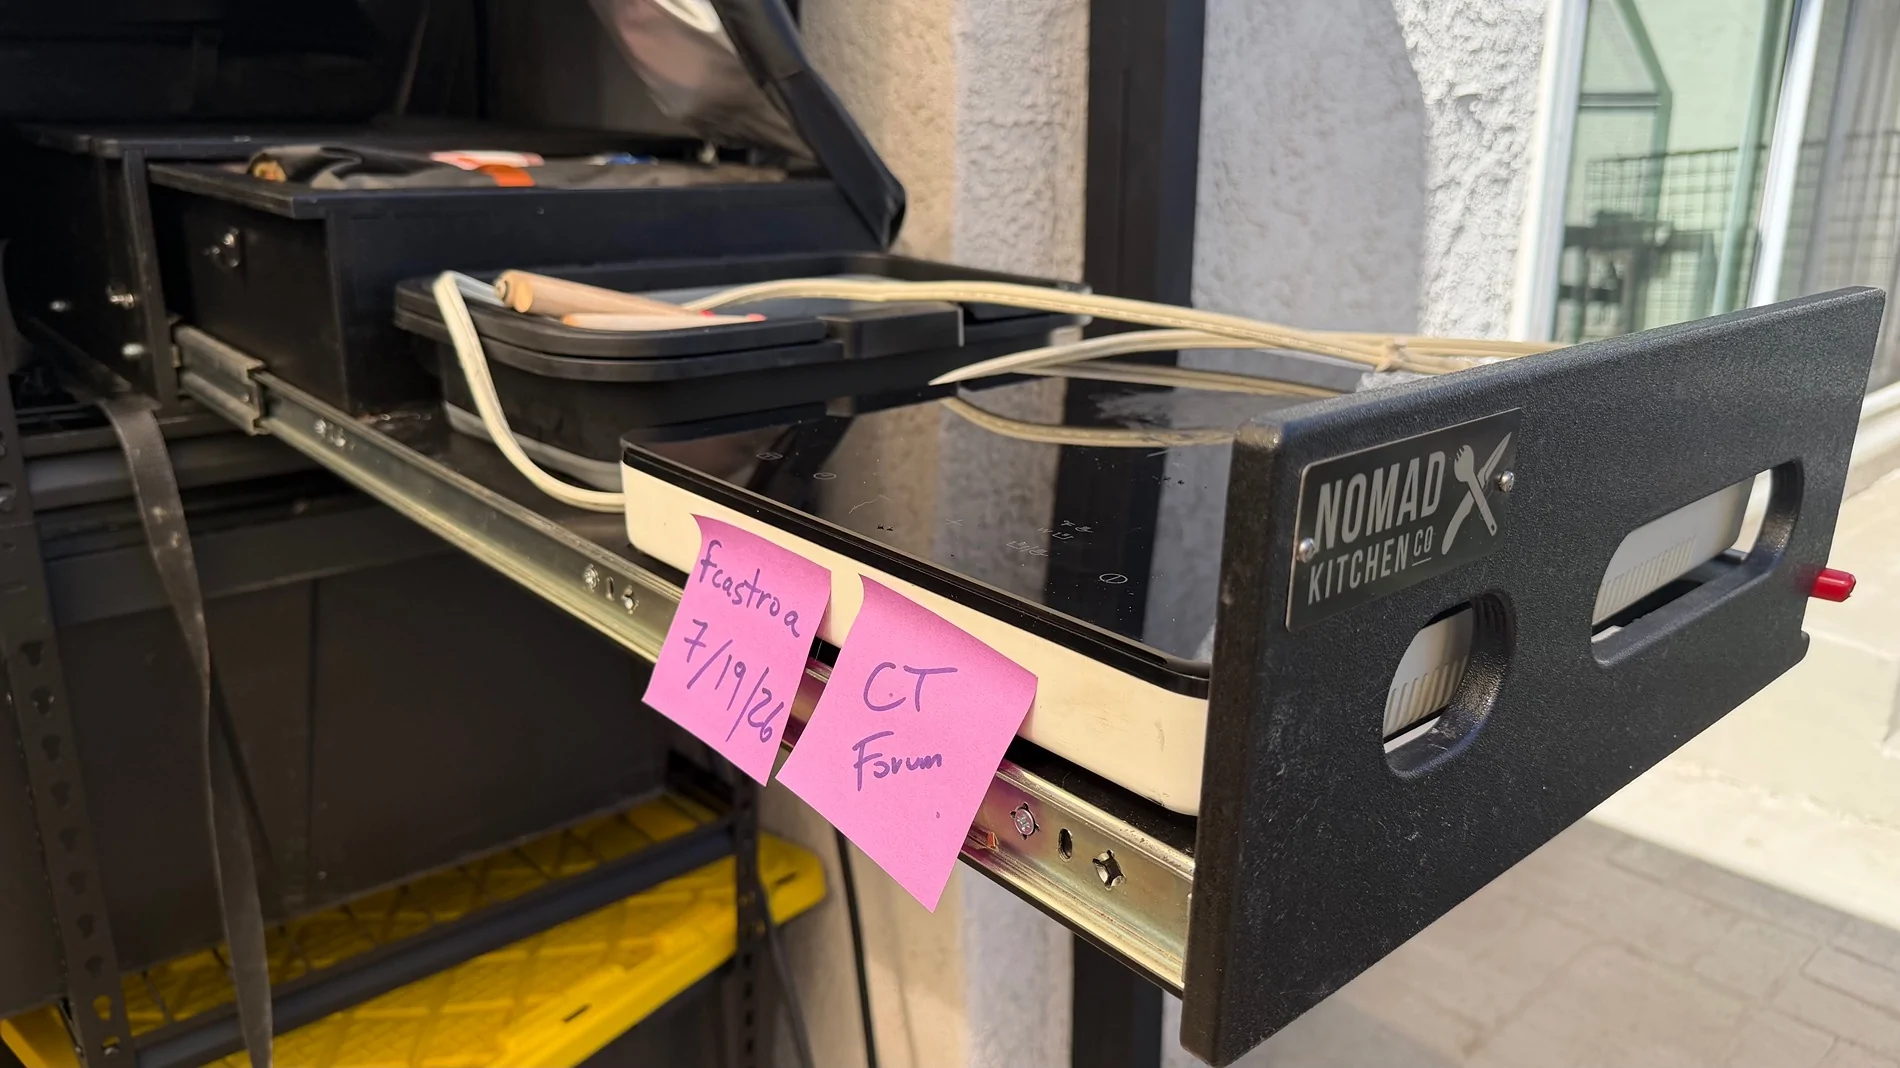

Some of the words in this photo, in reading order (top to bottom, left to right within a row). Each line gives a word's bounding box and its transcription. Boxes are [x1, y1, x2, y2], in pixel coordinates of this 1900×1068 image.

[1313, 450, 1446, 554] NOMAD
[699, 539, 801, 638] fcastroa
[1307, 532, 1410, 605] KITCHEN
[1413, 525, 1434, 557] CO
[683, 618, 786, 743] 7/19/26
[862, 661, 958, 713] CT
[851, 730, 943, 792] Forum
